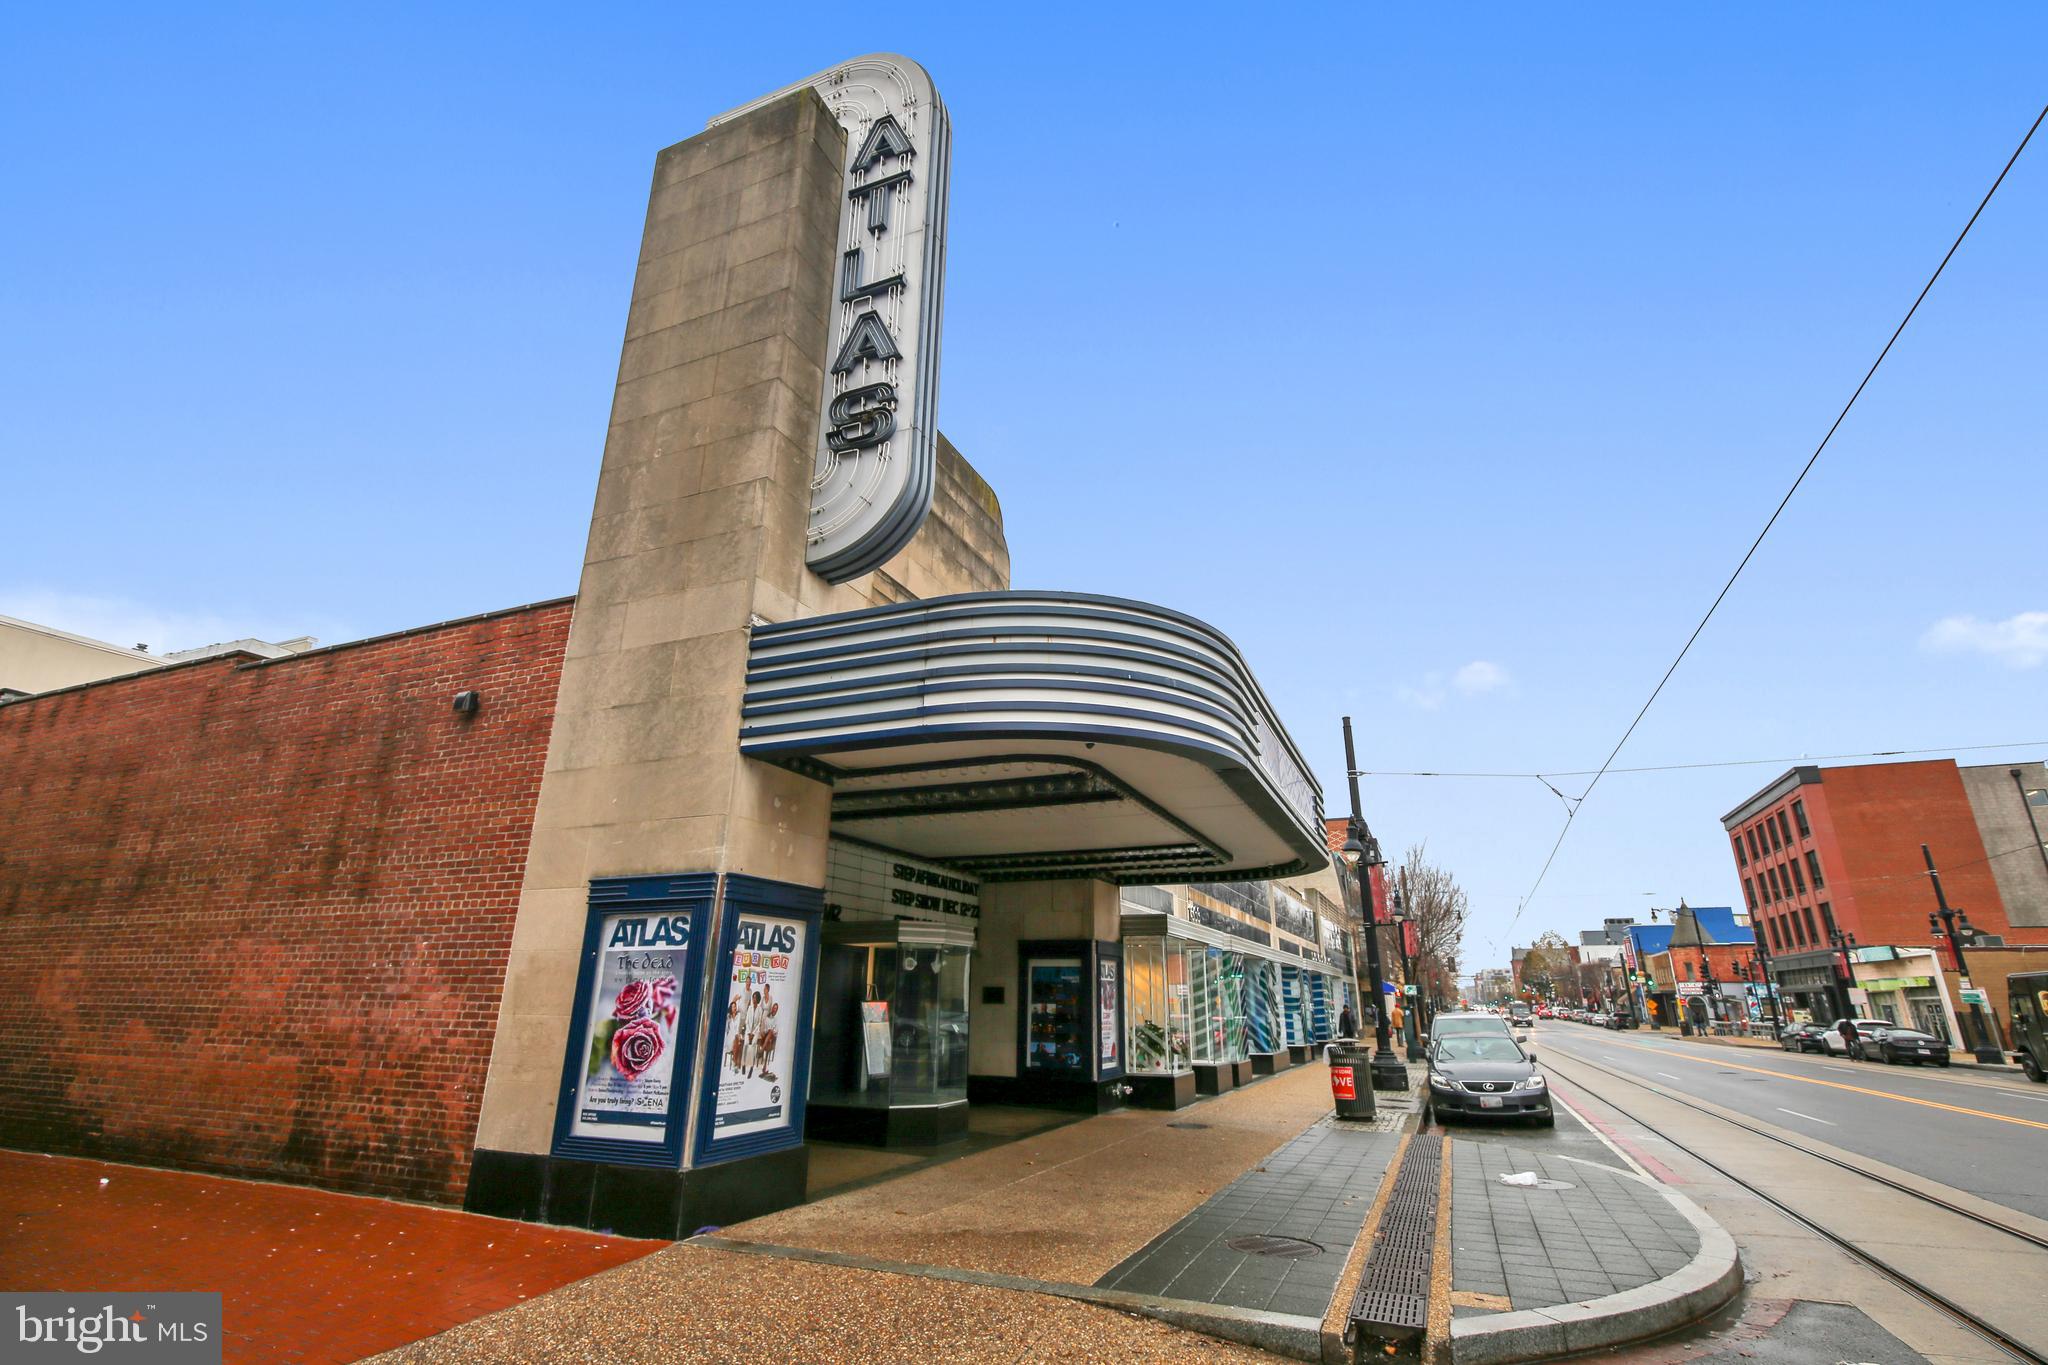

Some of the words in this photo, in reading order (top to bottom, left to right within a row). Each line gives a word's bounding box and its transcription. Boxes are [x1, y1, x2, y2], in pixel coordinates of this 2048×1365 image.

[826, 112, 917, 454] ATLAS
[608, 916, 690, 948] ATLAS
[738, 921, 796, 953] ATLAS
[739, 970, 767, 984] DAY
